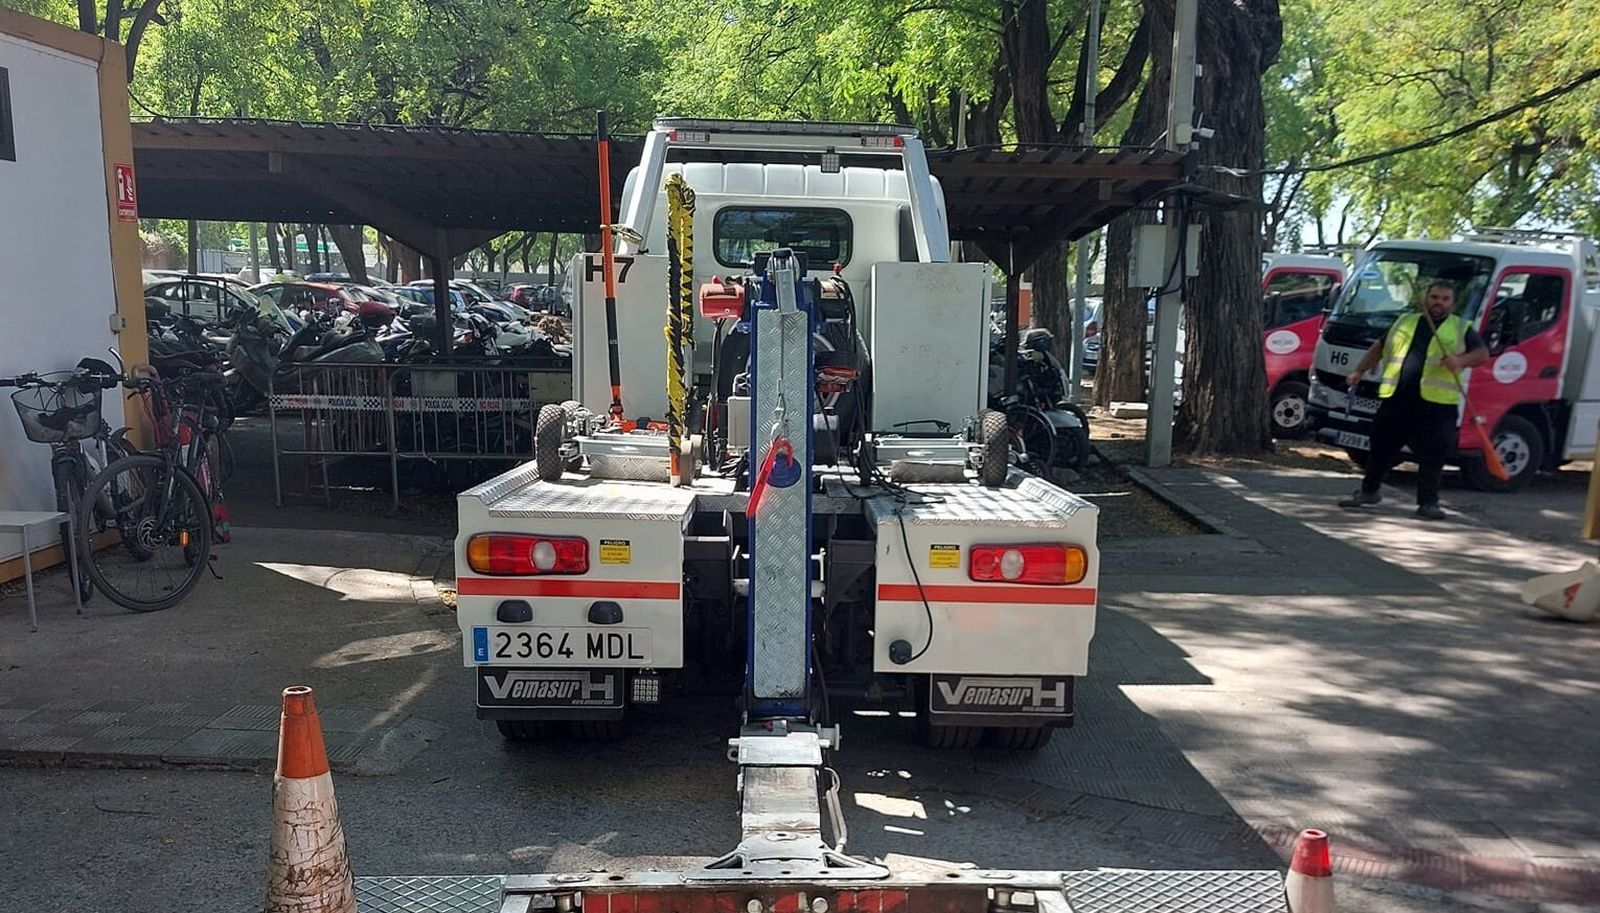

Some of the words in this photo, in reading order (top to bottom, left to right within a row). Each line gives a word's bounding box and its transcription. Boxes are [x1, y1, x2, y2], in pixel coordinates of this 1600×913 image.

[1330, 350, 1349, 366] H6
[478, 648, 485, 657] E
[496, 632, 573, 659] 2364
[587, 633, 644, 660] MDL
